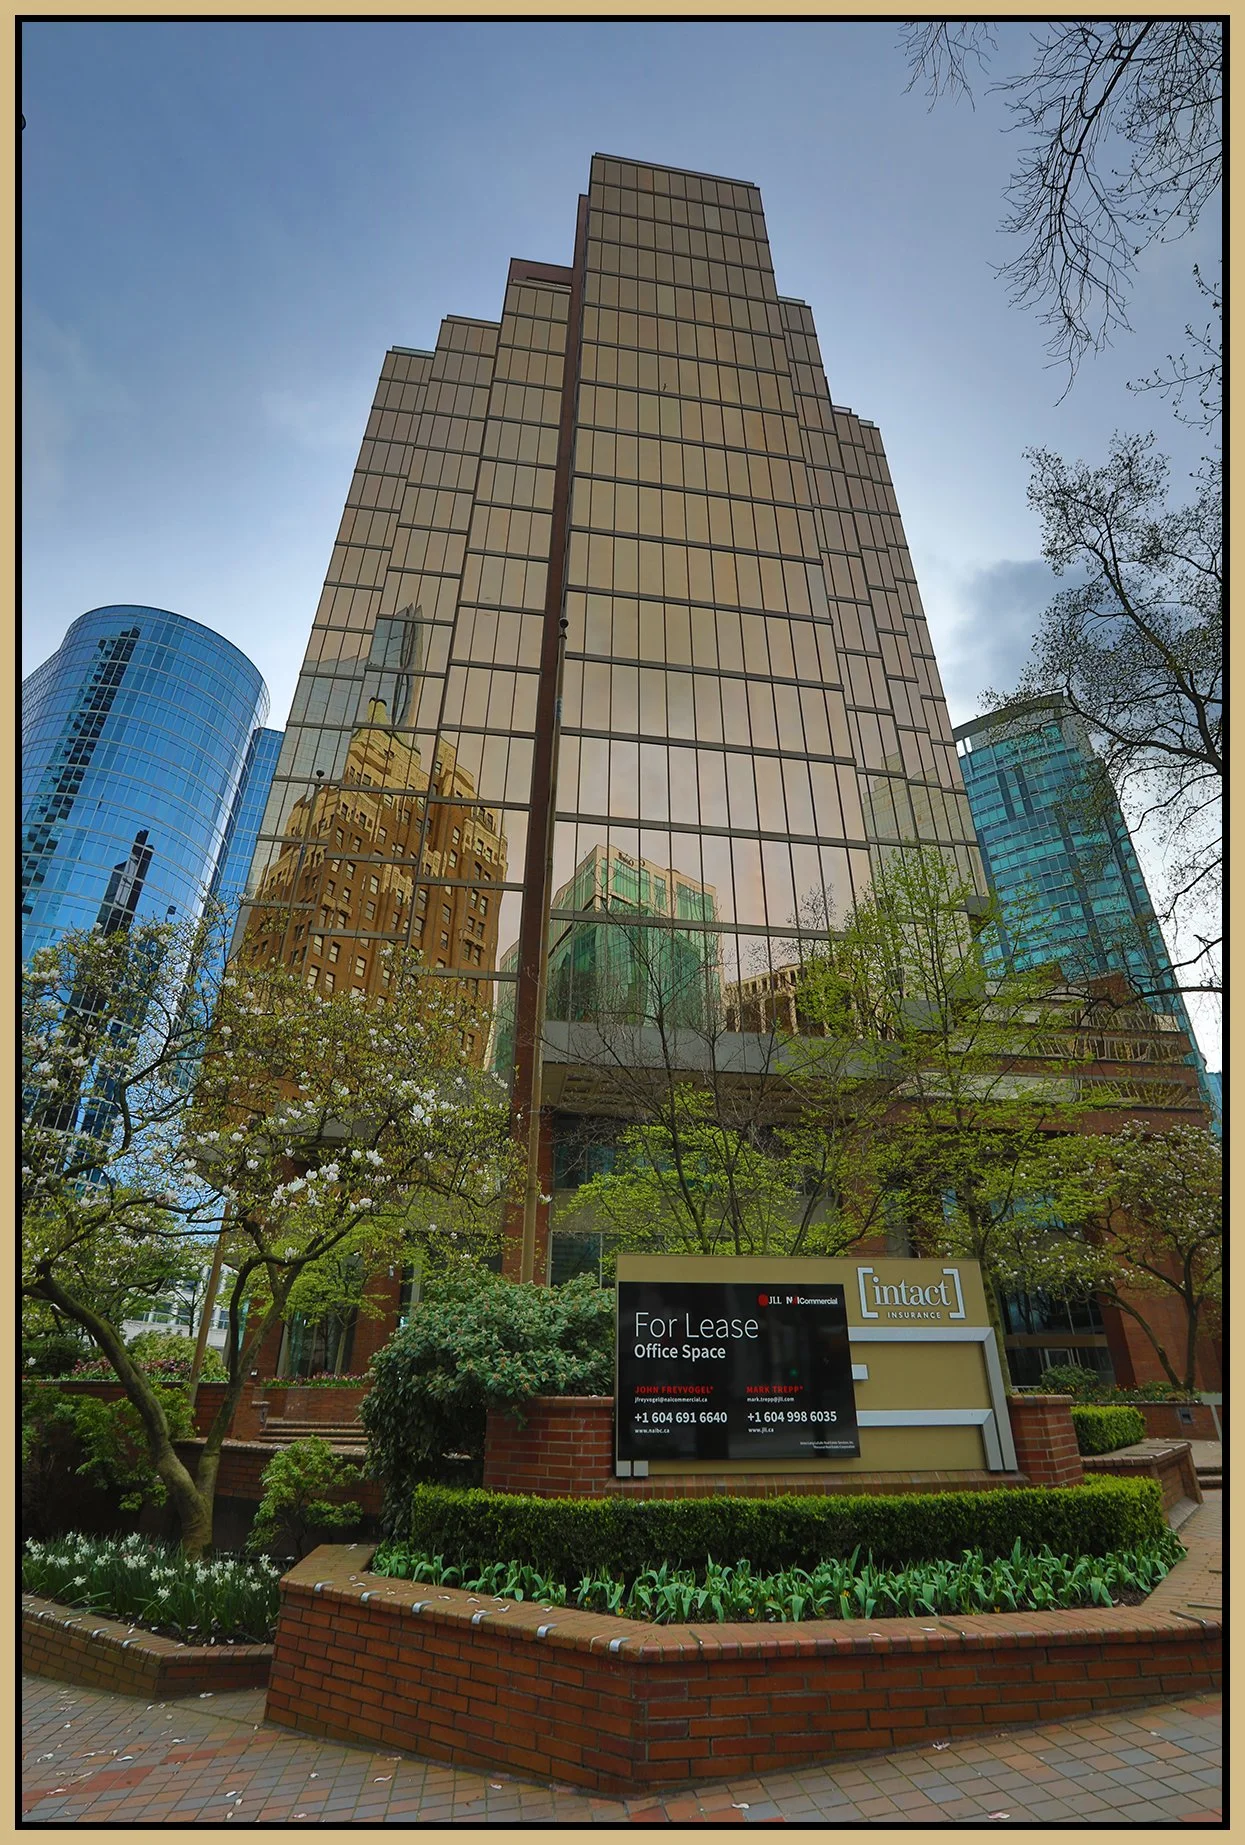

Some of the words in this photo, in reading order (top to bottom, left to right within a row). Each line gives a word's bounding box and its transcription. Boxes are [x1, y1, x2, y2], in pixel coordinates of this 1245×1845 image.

[873, 1276, 951, 1306] intact
[768, 1296, 782, 1305] JLL
[887, 1311, 941, 1319] INSURANCE
[635, 1312, 678, 1338] For
[686, 1312, 759, 1338] Lease
[634, 1343, 678, 1359] Office
[682, 1344, 726, 1362] Space
[635, 1386, 659, 1394] JOHN
[634, 1412, 649, 1423] +1
[651, 1412, 673, 1423] 604
[675, 1412, 697, 1423] 691
[699, 1412, 728, 1423] 6640
[747, 1411, 762, 1423] +1
[763, 1411, 785, 1423] 604
[786, 1411, 808, 1422] 998
[809, 1411, 837, 1422] 6035
